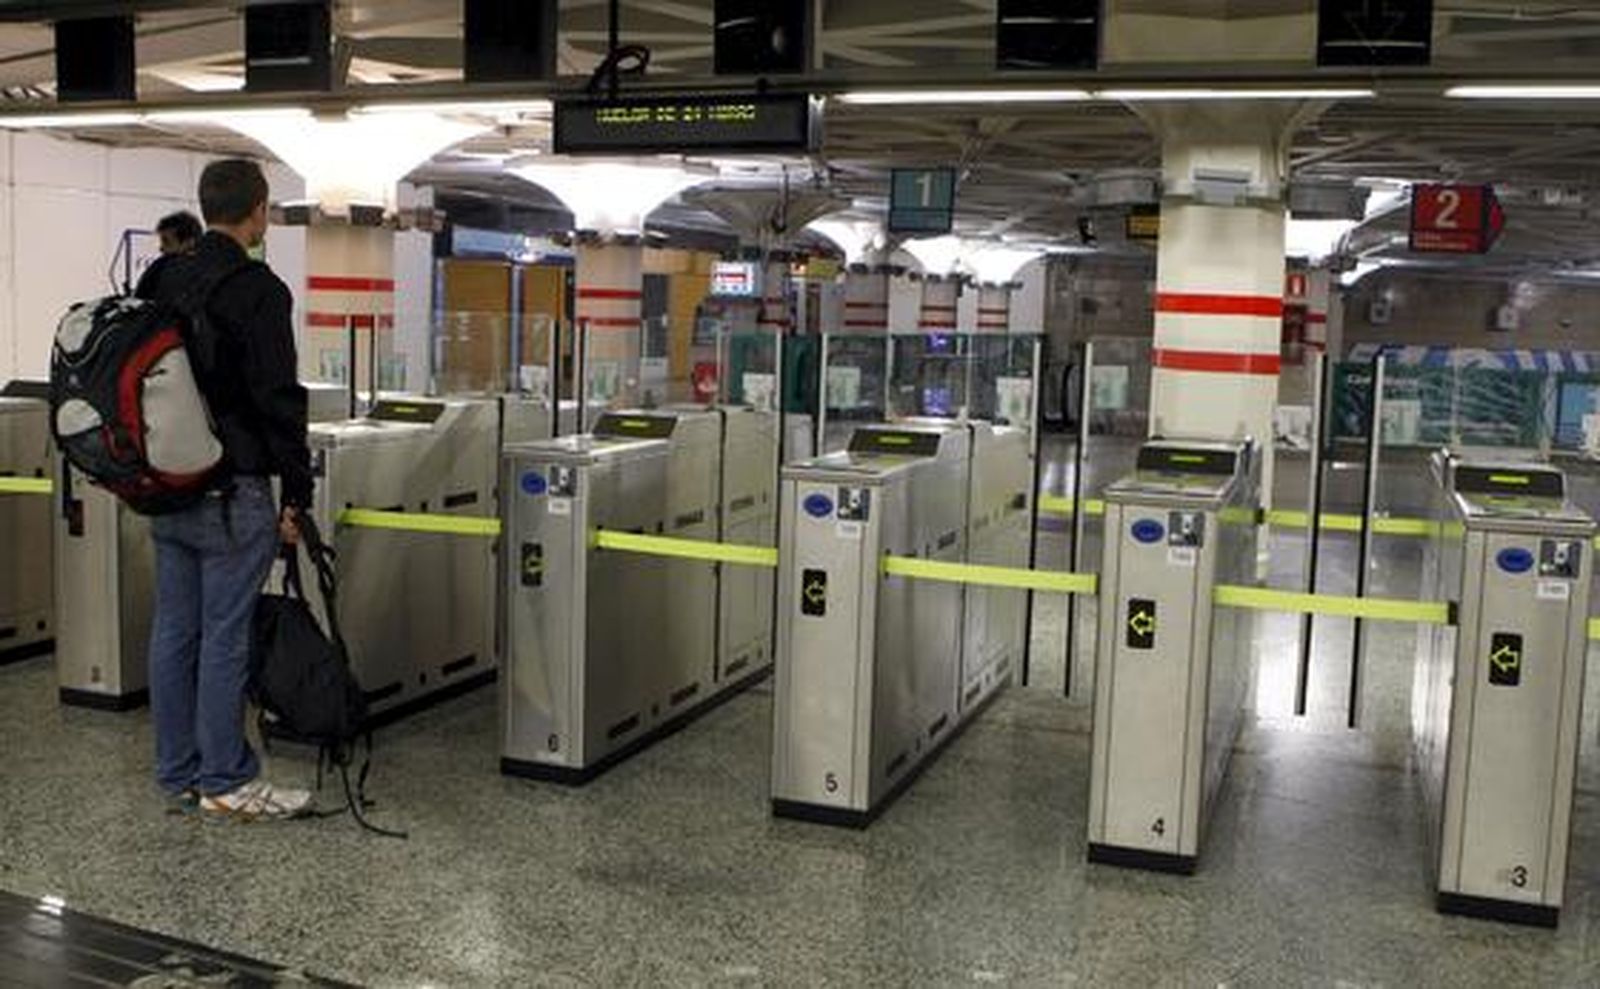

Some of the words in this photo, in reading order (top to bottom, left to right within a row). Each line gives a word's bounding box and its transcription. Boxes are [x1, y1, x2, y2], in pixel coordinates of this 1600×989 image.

[915, 172, 932, 208] 1
[1436, 189, 1460, 228] 2
[825, 772, 839, 793] 5
[1151, 817, 1165, 836] 4
[1511, 865, 1528, 888] 3
